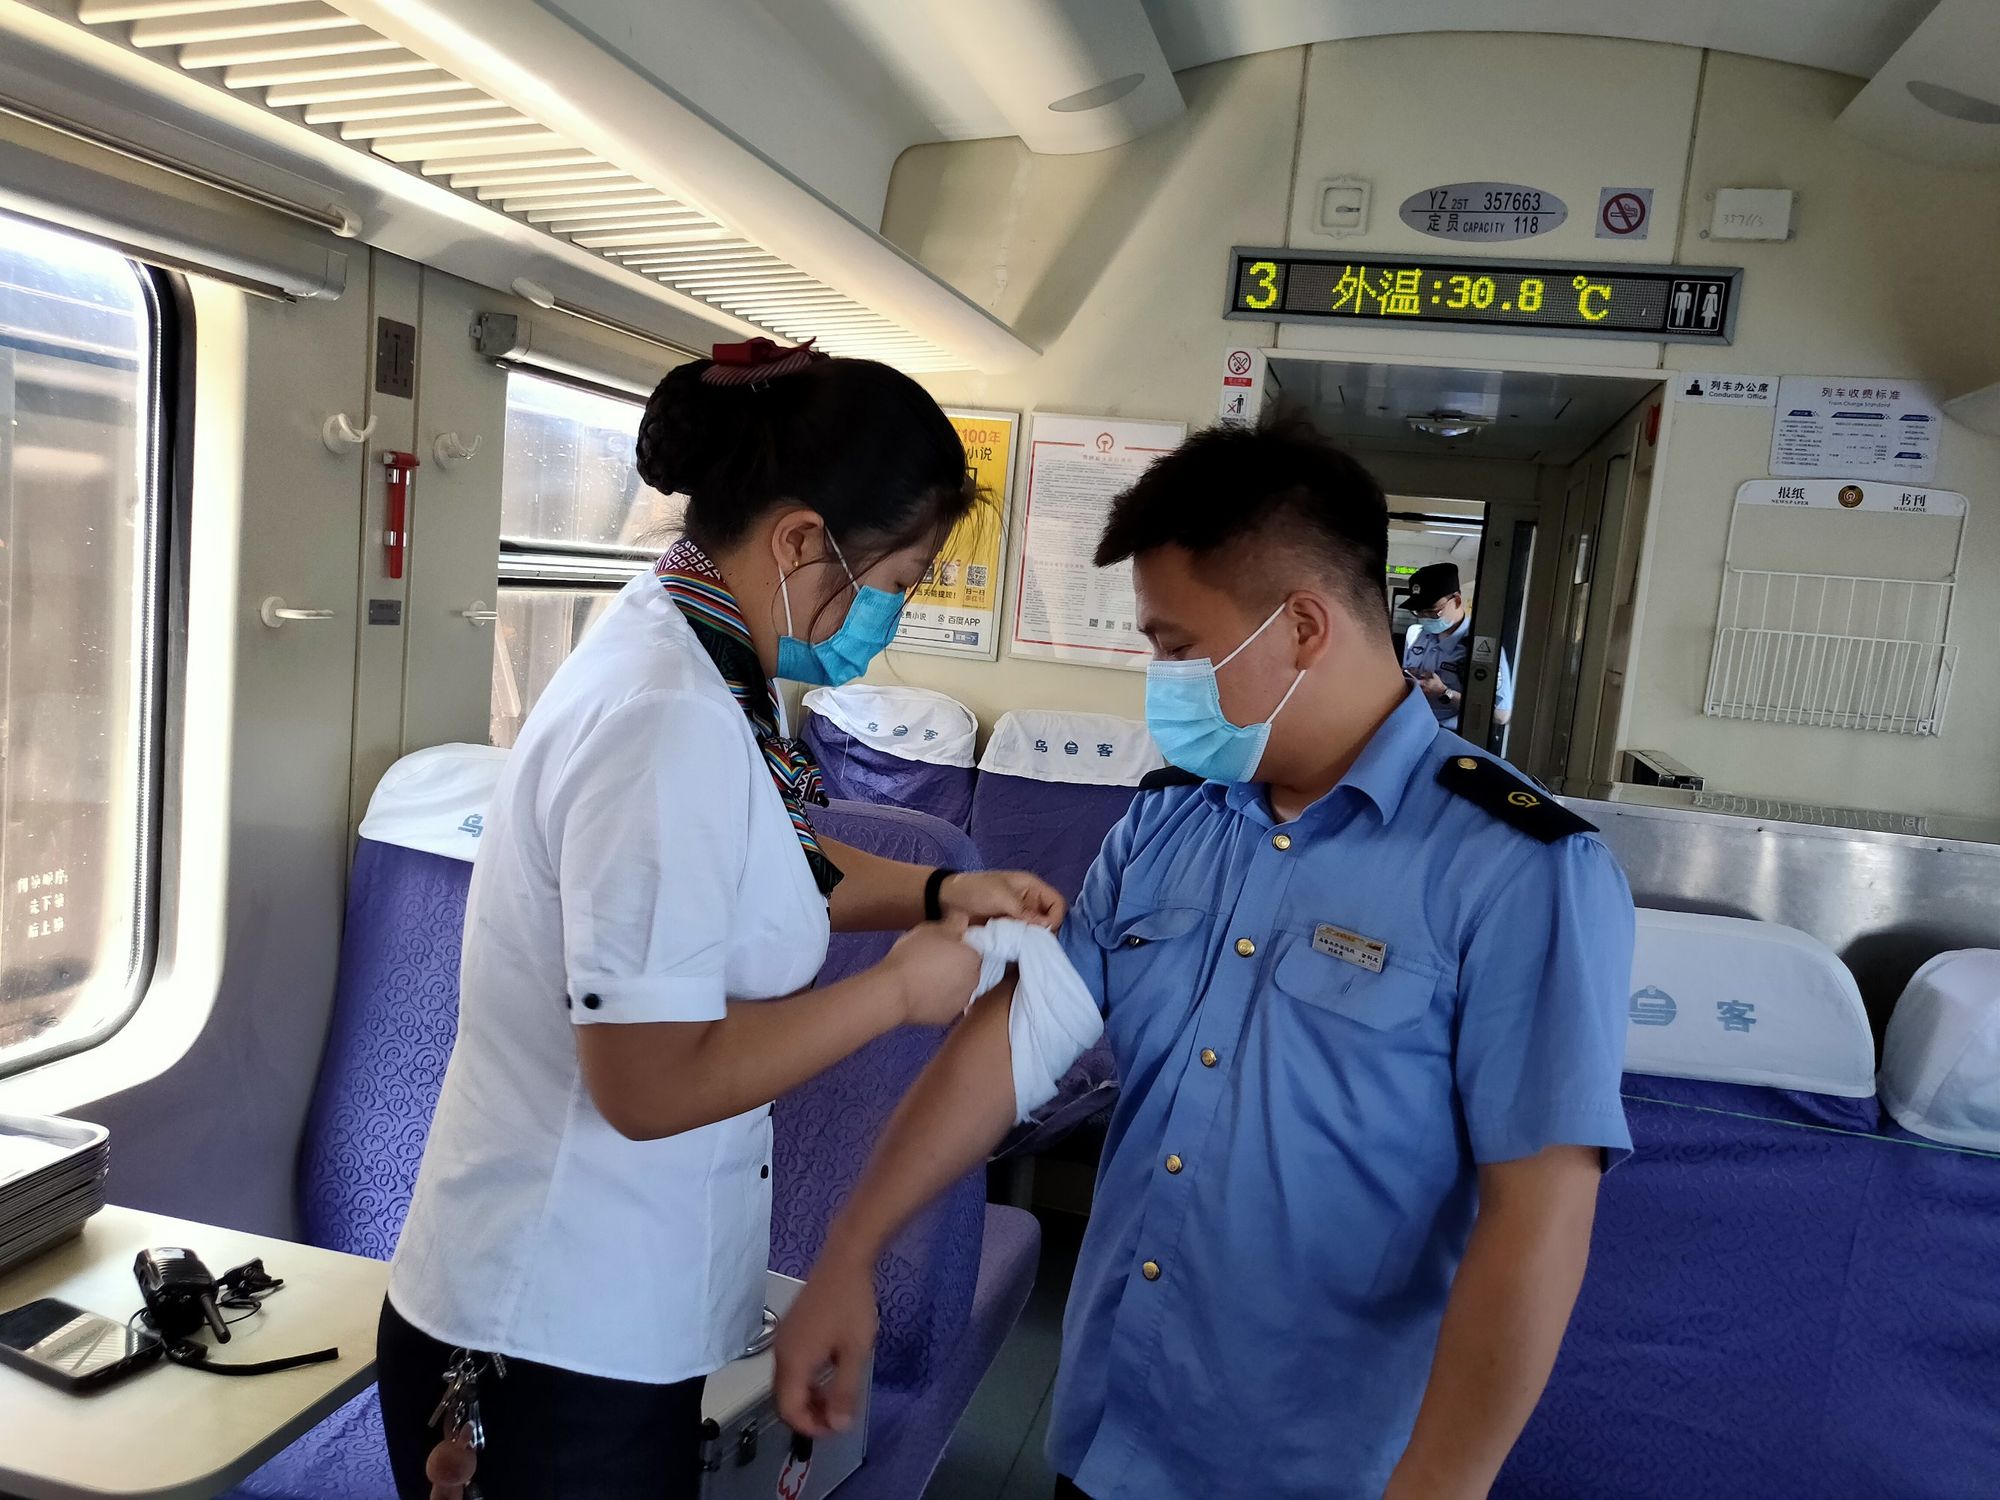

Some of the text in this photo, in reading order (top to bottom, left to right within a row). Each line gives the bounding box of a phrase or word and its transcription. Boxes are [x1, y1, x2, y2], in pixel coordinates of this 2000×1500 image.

[1429, 191, 1541, 211] YZ 25T 357663
[1427, 213, 1539, 234] 定员 CAPACITY 118
[1246, 261, 1278, 309] 3
[1710, 380, 1769, 393] 列车办公席
[1821, 387, 1901, 400] 列车收费标准
[1708, 391, 1744, 399] Conductor
[959, 429, 1001, 444] 100年
[966, 446, 993, 461] 小说
[1777, 485, 1805, 500] 报纸
[1899, 492, 1927, 507] 书刊
[1716, 1000, 1757, 1033] 客
